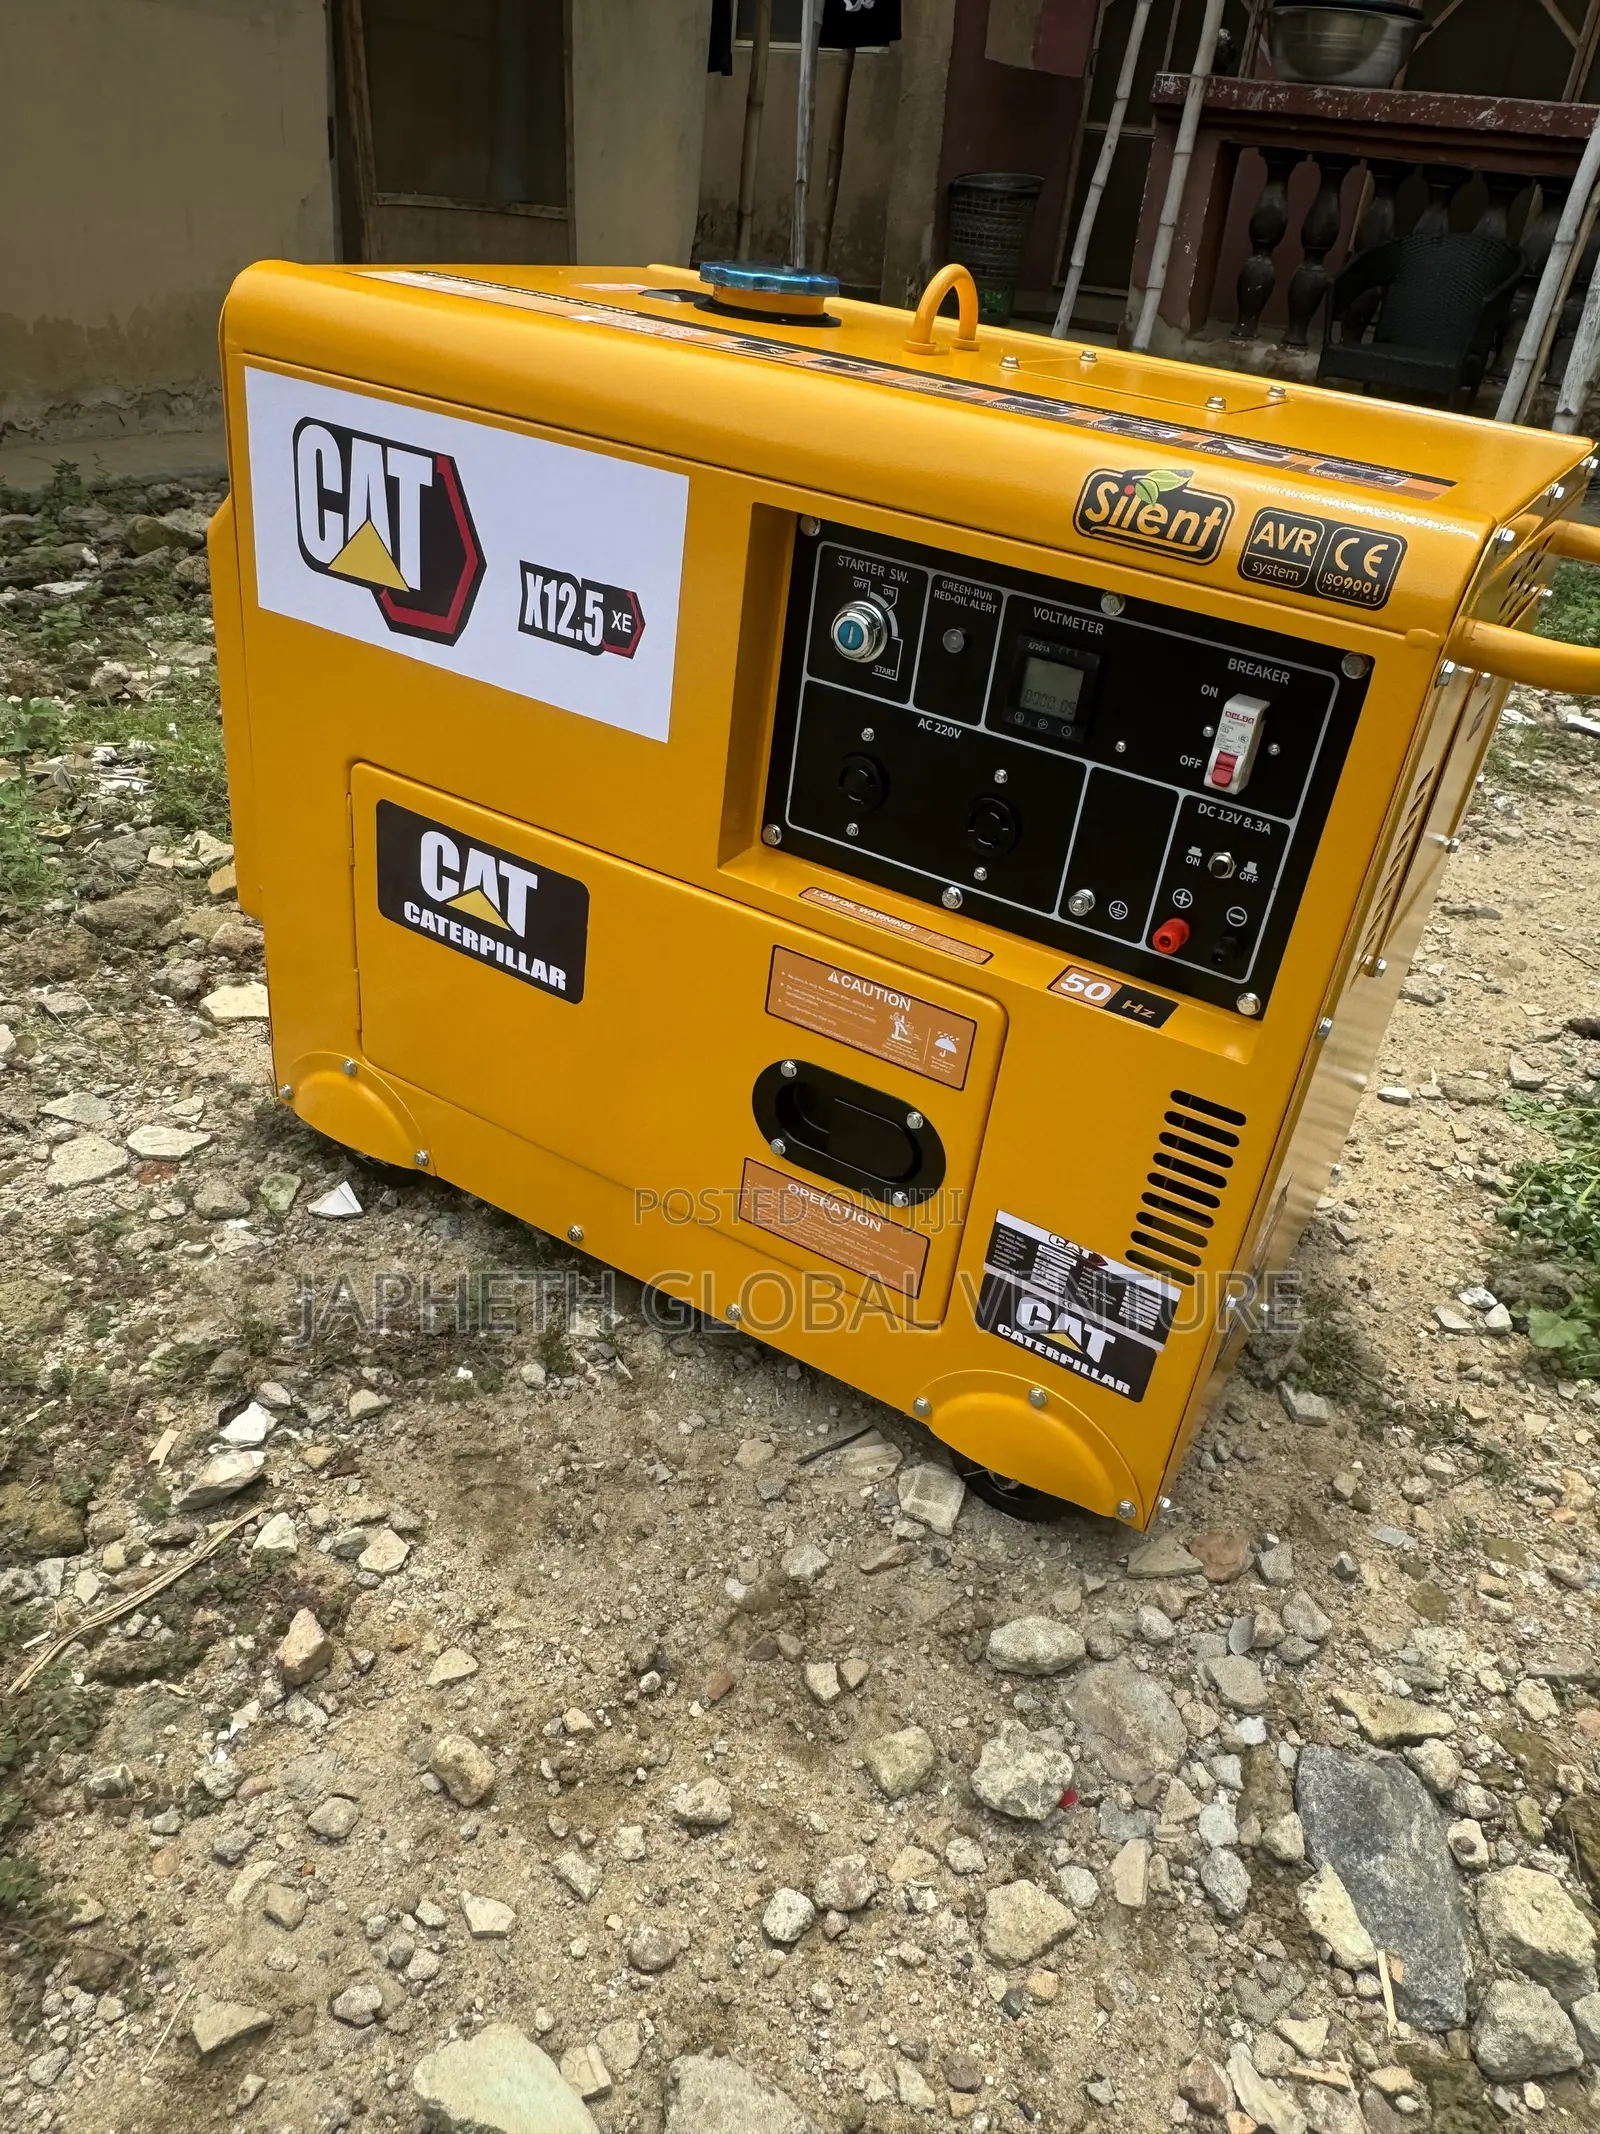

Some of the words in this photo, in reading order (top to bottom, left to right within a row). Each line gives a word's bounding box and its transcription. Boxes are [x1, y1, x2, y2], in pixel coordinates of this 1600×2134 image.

[300, 424, 433, 591] CAT
[1085, 480, 1224, 548] Silent
[1252, 520, 1319, 558] AVR
[837, 555, 885, 578] STARTER
[889, 568, 909, 584] SW.
[1251, 560, 1300, 582] system
[1334, 537, 1389, 578] CE
[853, 580, 868, 591] OFF
[883, 587, 895, 598] ON
[941, 580, 993, 601] GREEN-RUN
[1322, 572, 1381, 597] ISO9001
[524, 571, 604, 647] X12.5
[610, 609, 632, 635] XE
[934, 589, 969, 607] RED-OIL
[969, 599, 997, 614] ALERT
[1033, 606, 1104, 636] VOLTMETER
[874, 664, 896, 677] START
[1227, 657, 1291, 685] BREAKER
[1200, 684, 1218, 698] ON
[918, 718, 933, 731] AC
[934, 722, 962, 739] 220V
[1180, 755, 1202, 770] OFF
[1197, 802, 1216, 818] DC
[1217, 808, 1241, 826] 12V
[1243, 816, 1271, 835] 8.3A
[1186, 854, 1200, 866] ON
[420, 831, 538, 938] CAT
[1239, 871, 1259, 884] OFF
[404, 900, 567, 991] CATERPILLAR
[841, 975, 912, 1012] CAUTION
[1060, 973, 1113, 1001] 50
[1121, 998, 1156, 1019] Hz
[787, 1183, 882, 1233] OPERATION
[1050, 1234, 1095, 1258] CAT
[1016, 1297, 1116, 1364] CAT
[997, 1323, 1132, 1395] CATERPILLAR
